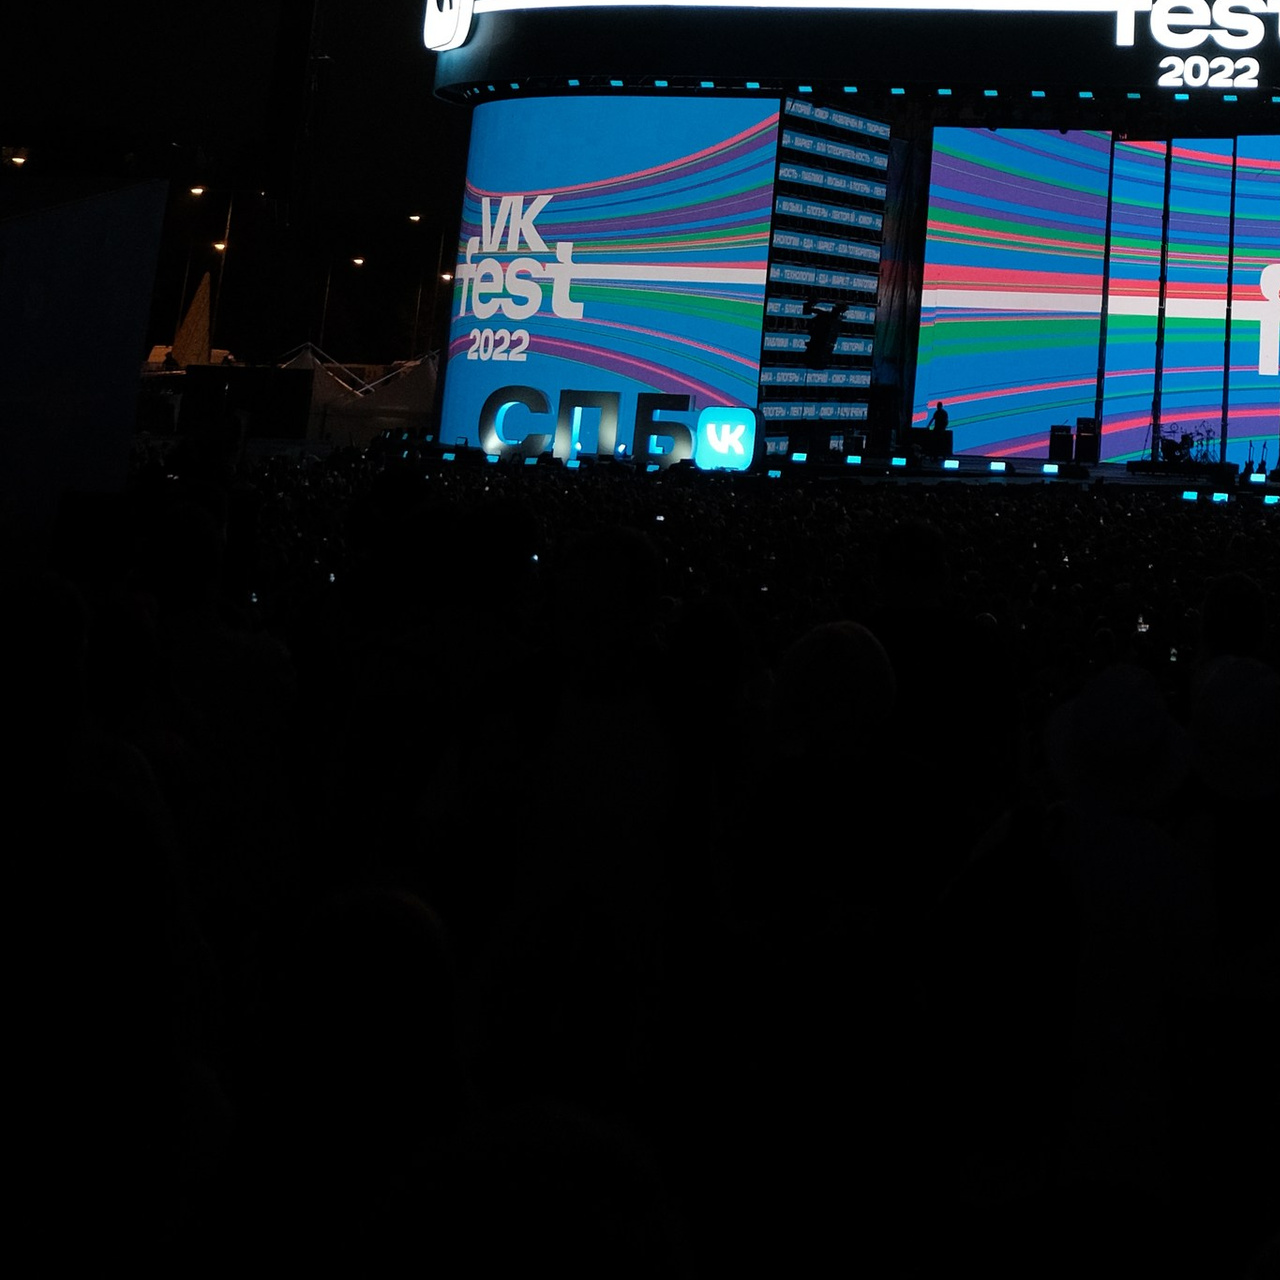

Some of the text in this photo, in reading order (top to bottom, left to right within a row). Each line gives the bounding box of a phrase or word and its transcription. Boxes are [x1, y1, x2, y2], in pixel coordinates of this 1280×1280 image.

[1157, 56, 1260, 88] 2022
[482, 195, 554, 252] VK
[459, 237, 584, 320] fest
[467, 328, 530, 362] 2022
[478, 385, 697, 470] СПБ
[706, 423, 746, 455] VK
